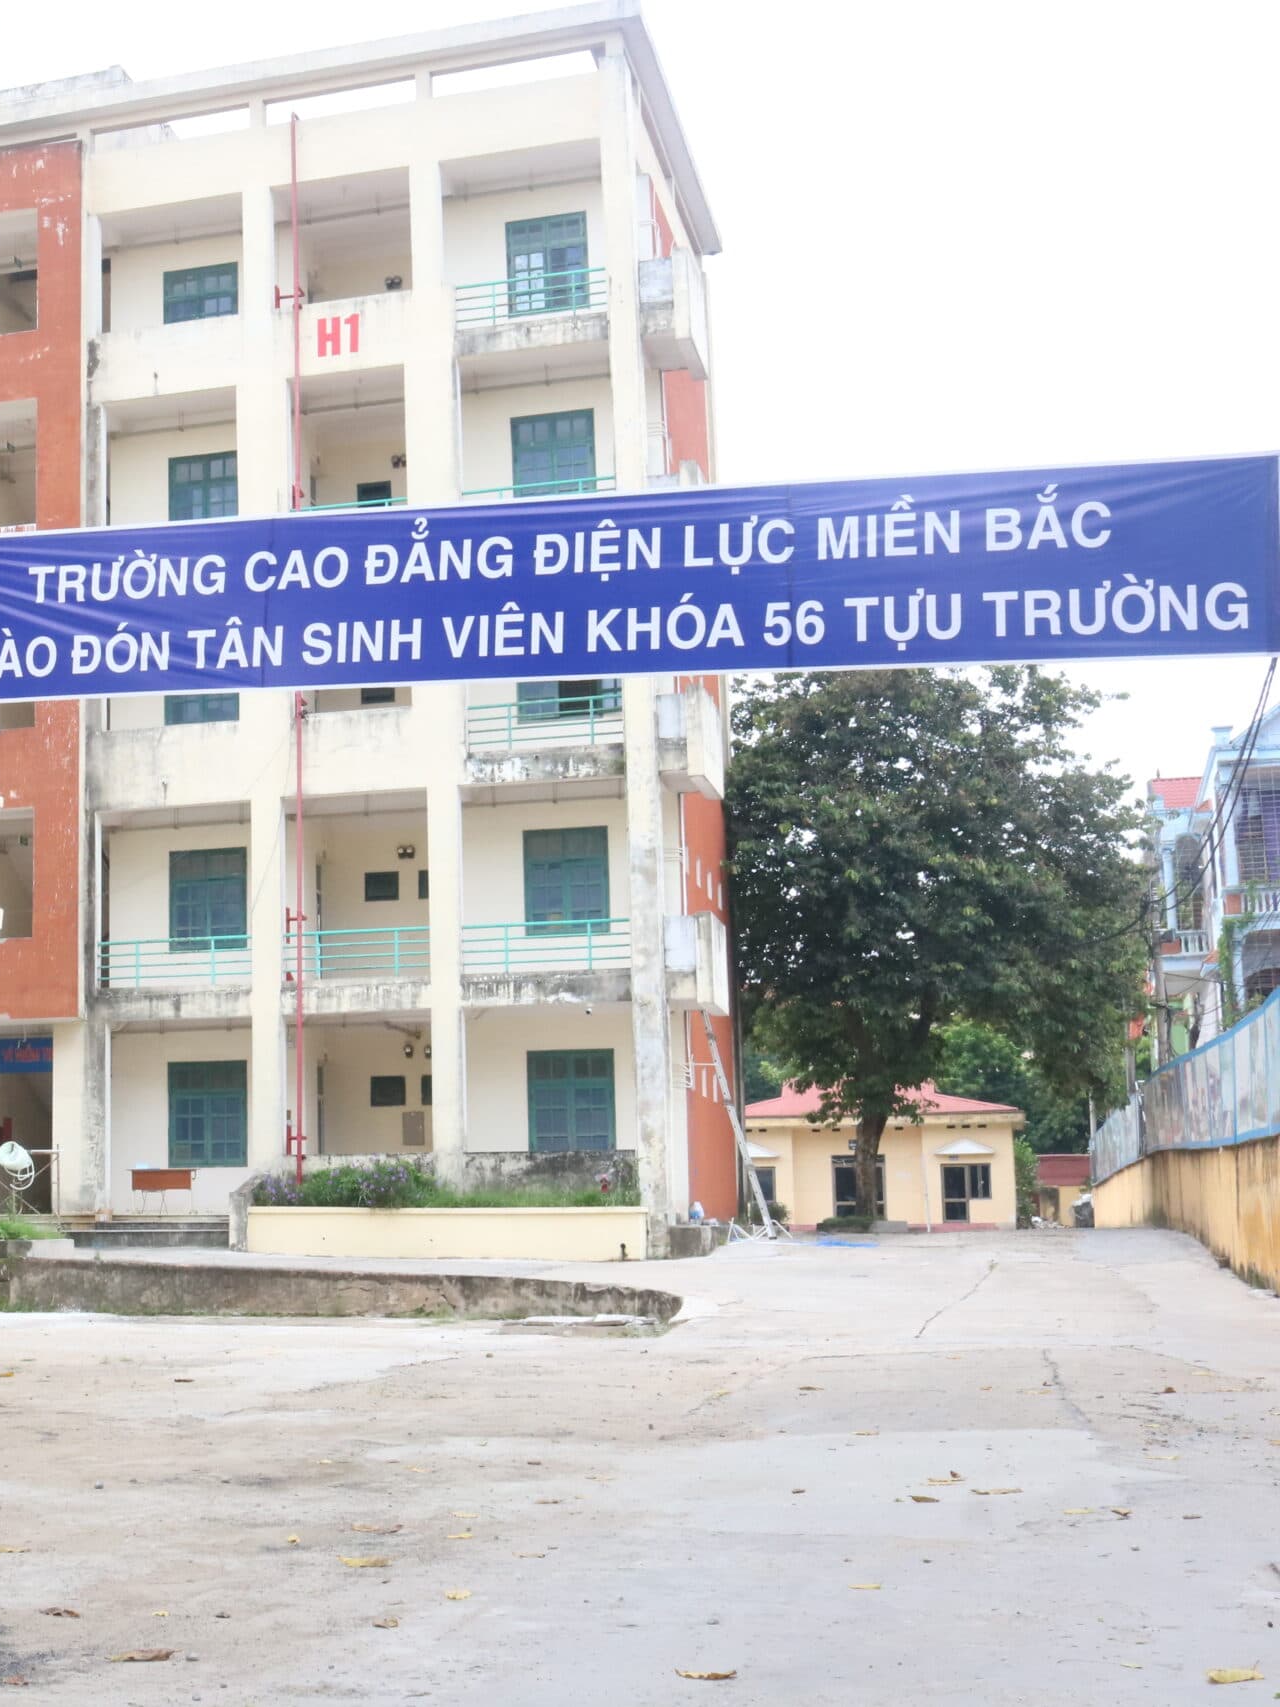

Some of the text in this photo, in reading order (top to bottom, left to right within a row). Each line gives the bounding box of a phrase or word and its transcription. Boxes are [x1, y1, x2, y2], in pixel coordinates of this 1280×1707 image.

[317, 313, 360, 358] H1
[28, 483, 1111, 604] TRƯỜNG CAO ĐẲNG ĐIỆN LỰC MIỀN BẮC
[70, 621, 170, 675] ĐÓN
[187, 616, 284, 669] TÂN
[302, 618, 422, 666] SINH
[442, 601, 564, 658] VIÊN
[587, 592, 745, 653] KHÓA
[763, 600, 825, 646] 56
[844, 587, 962, 651] TỰU
[982, 573, 1249, 637] TRƯỜNG
